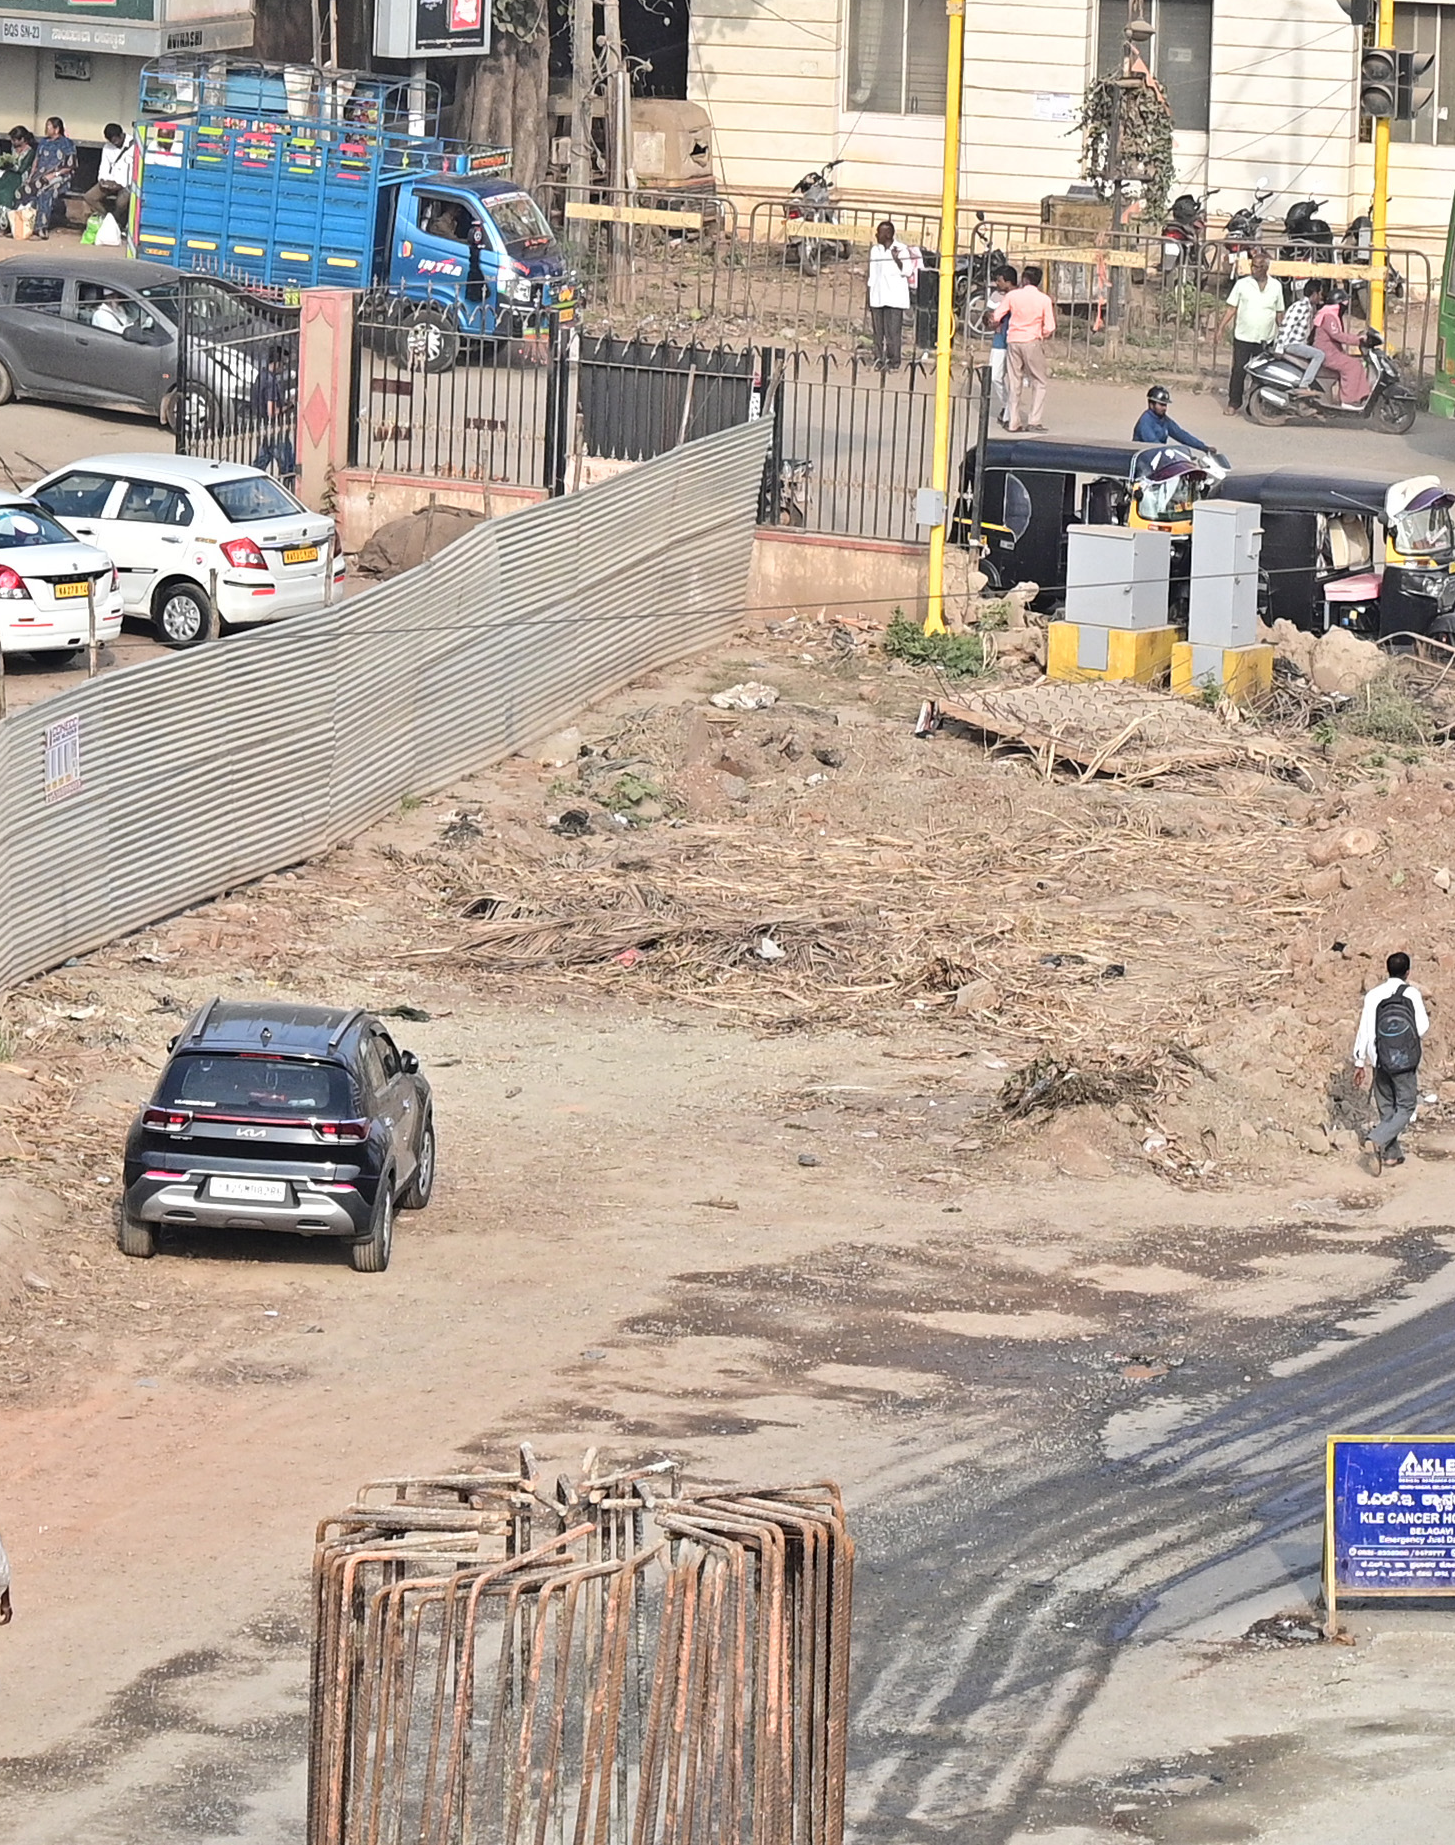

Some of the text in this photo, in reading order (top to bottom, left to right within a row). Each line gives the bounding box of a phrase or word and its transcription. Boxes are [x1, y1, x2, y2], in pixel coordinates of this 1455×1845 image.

[4, 23, 19, 37] BQS
[417, 259, 463, 277] INTRA
[1360, 1512, 1384, 1524] KLE
[1387, 1512, 1440, 1525] CANCER
[1409, 1527, 1454, 1536] BELAGAVI
[1378, 1535, 1425, 1545] Emergency
